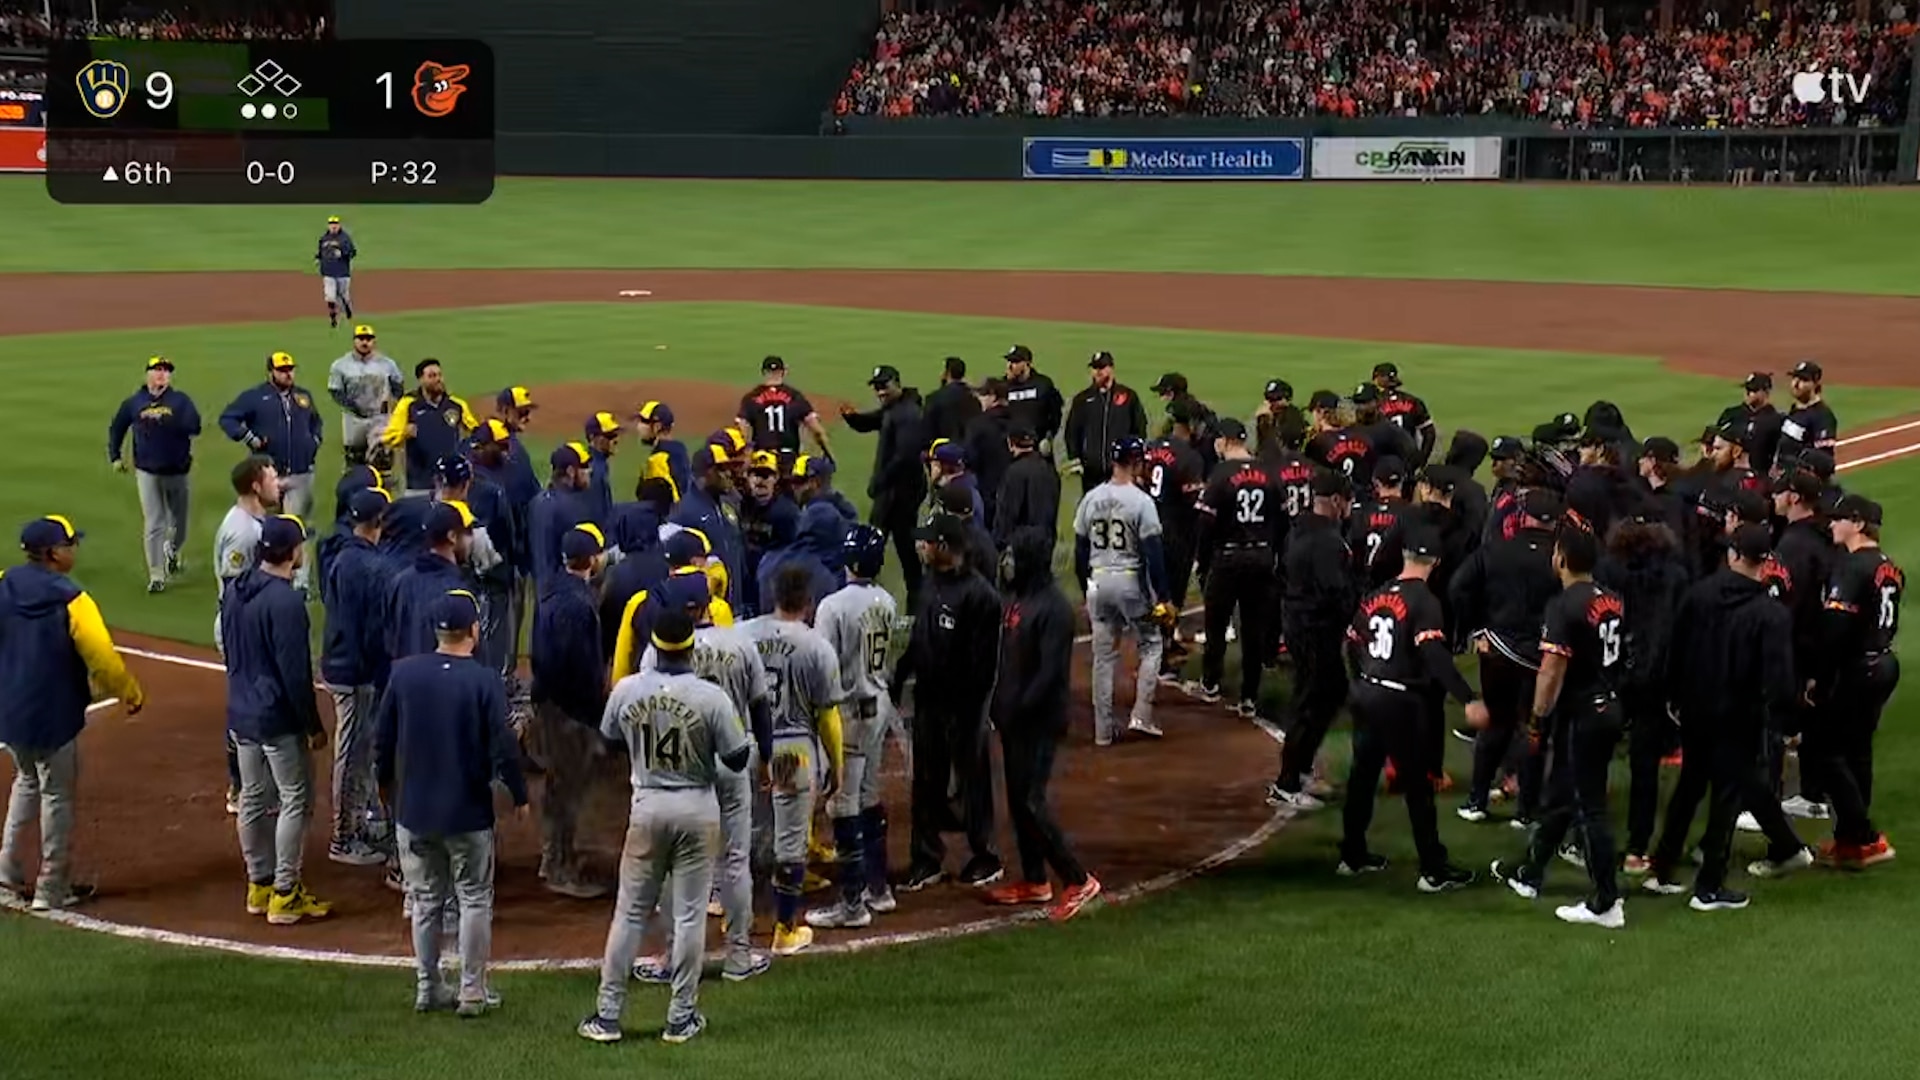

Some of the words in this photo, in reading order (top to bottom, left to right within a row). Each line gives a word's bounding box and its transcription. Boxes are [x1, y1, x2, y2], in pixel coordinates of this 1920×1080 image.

[1131, 150, 1207, 168] MedStar
[1211, 149, 1273, 168] Health
[764, 404, 785, 433] 11
[1150, 464, 1164, 497] 9
[1236, 488, 1265, 523] 32
[1092, 519, 1126, 550] 33
[866, 631, 889, 675] 16
[1368, 614, 1395, 660] 36
[641, 723, 681, 771] 14
